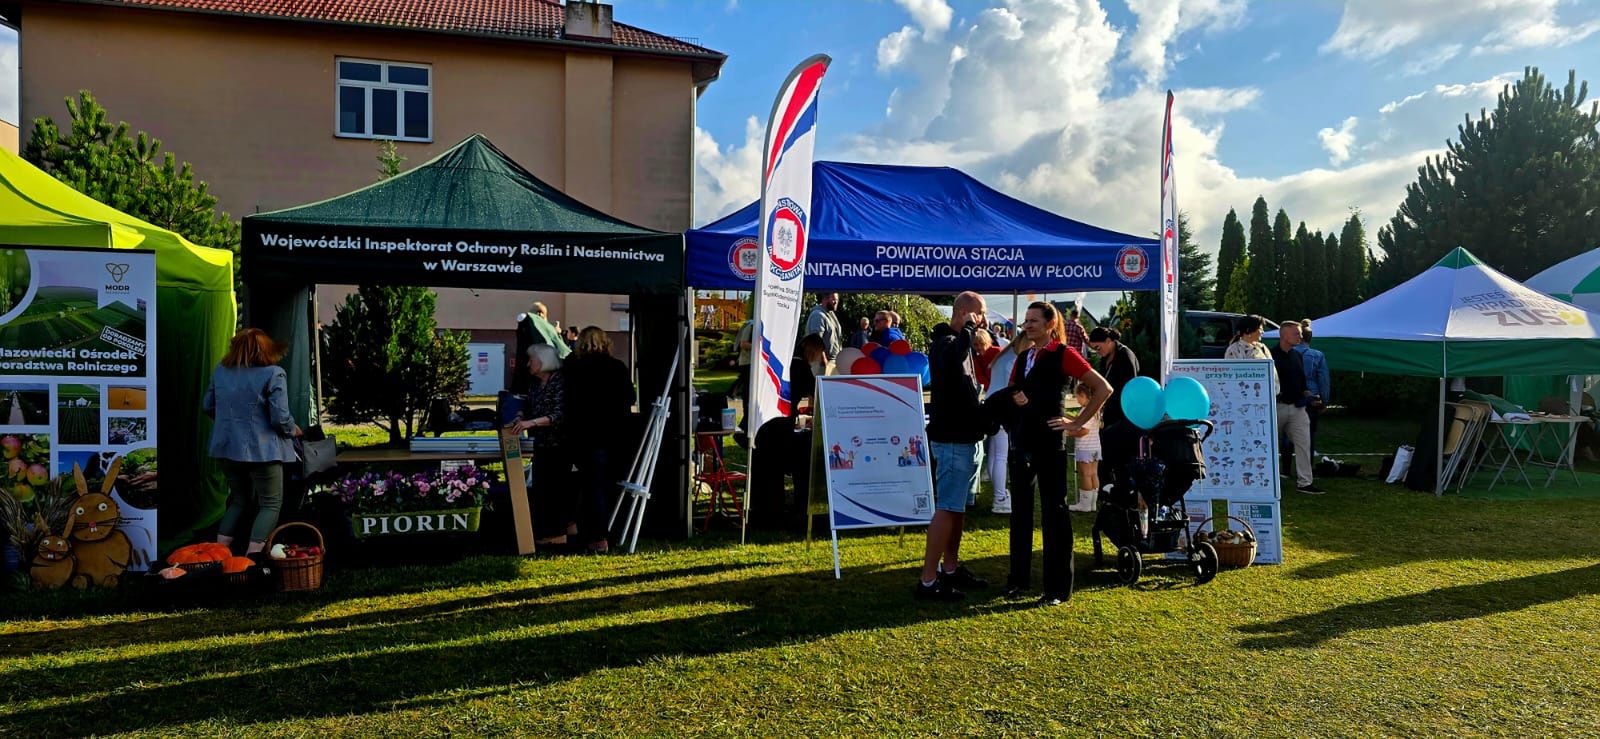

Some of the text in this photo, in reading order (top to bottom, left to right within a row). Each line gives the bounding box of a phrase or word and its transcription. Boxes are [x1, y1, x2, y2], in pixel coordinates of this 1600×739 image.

[260, 233, 665, 262] Wojewódzki Inspektorat Ochrony Roślin i Nasiennictwa
[876, 245, 1025, 261] POWIATOWA STACJA
[423, 259, 523, 273] w Warszawie
[804, 262, 1026, 279] NITARNO-EPIDEMIOLOGICZNA
[1029, 264, 1043, 278] W
[1046, 264, 1103, 279] PŁOCKU
[105, 284, 130, 292] MODR
[1481, 308, 1568, 327] ZUS
[80, 348, 138, 360] Ośrodek
[0, 360, 138, 374] oradztwa Rolniczego
[361, 513, 470, 535] PIORIN
